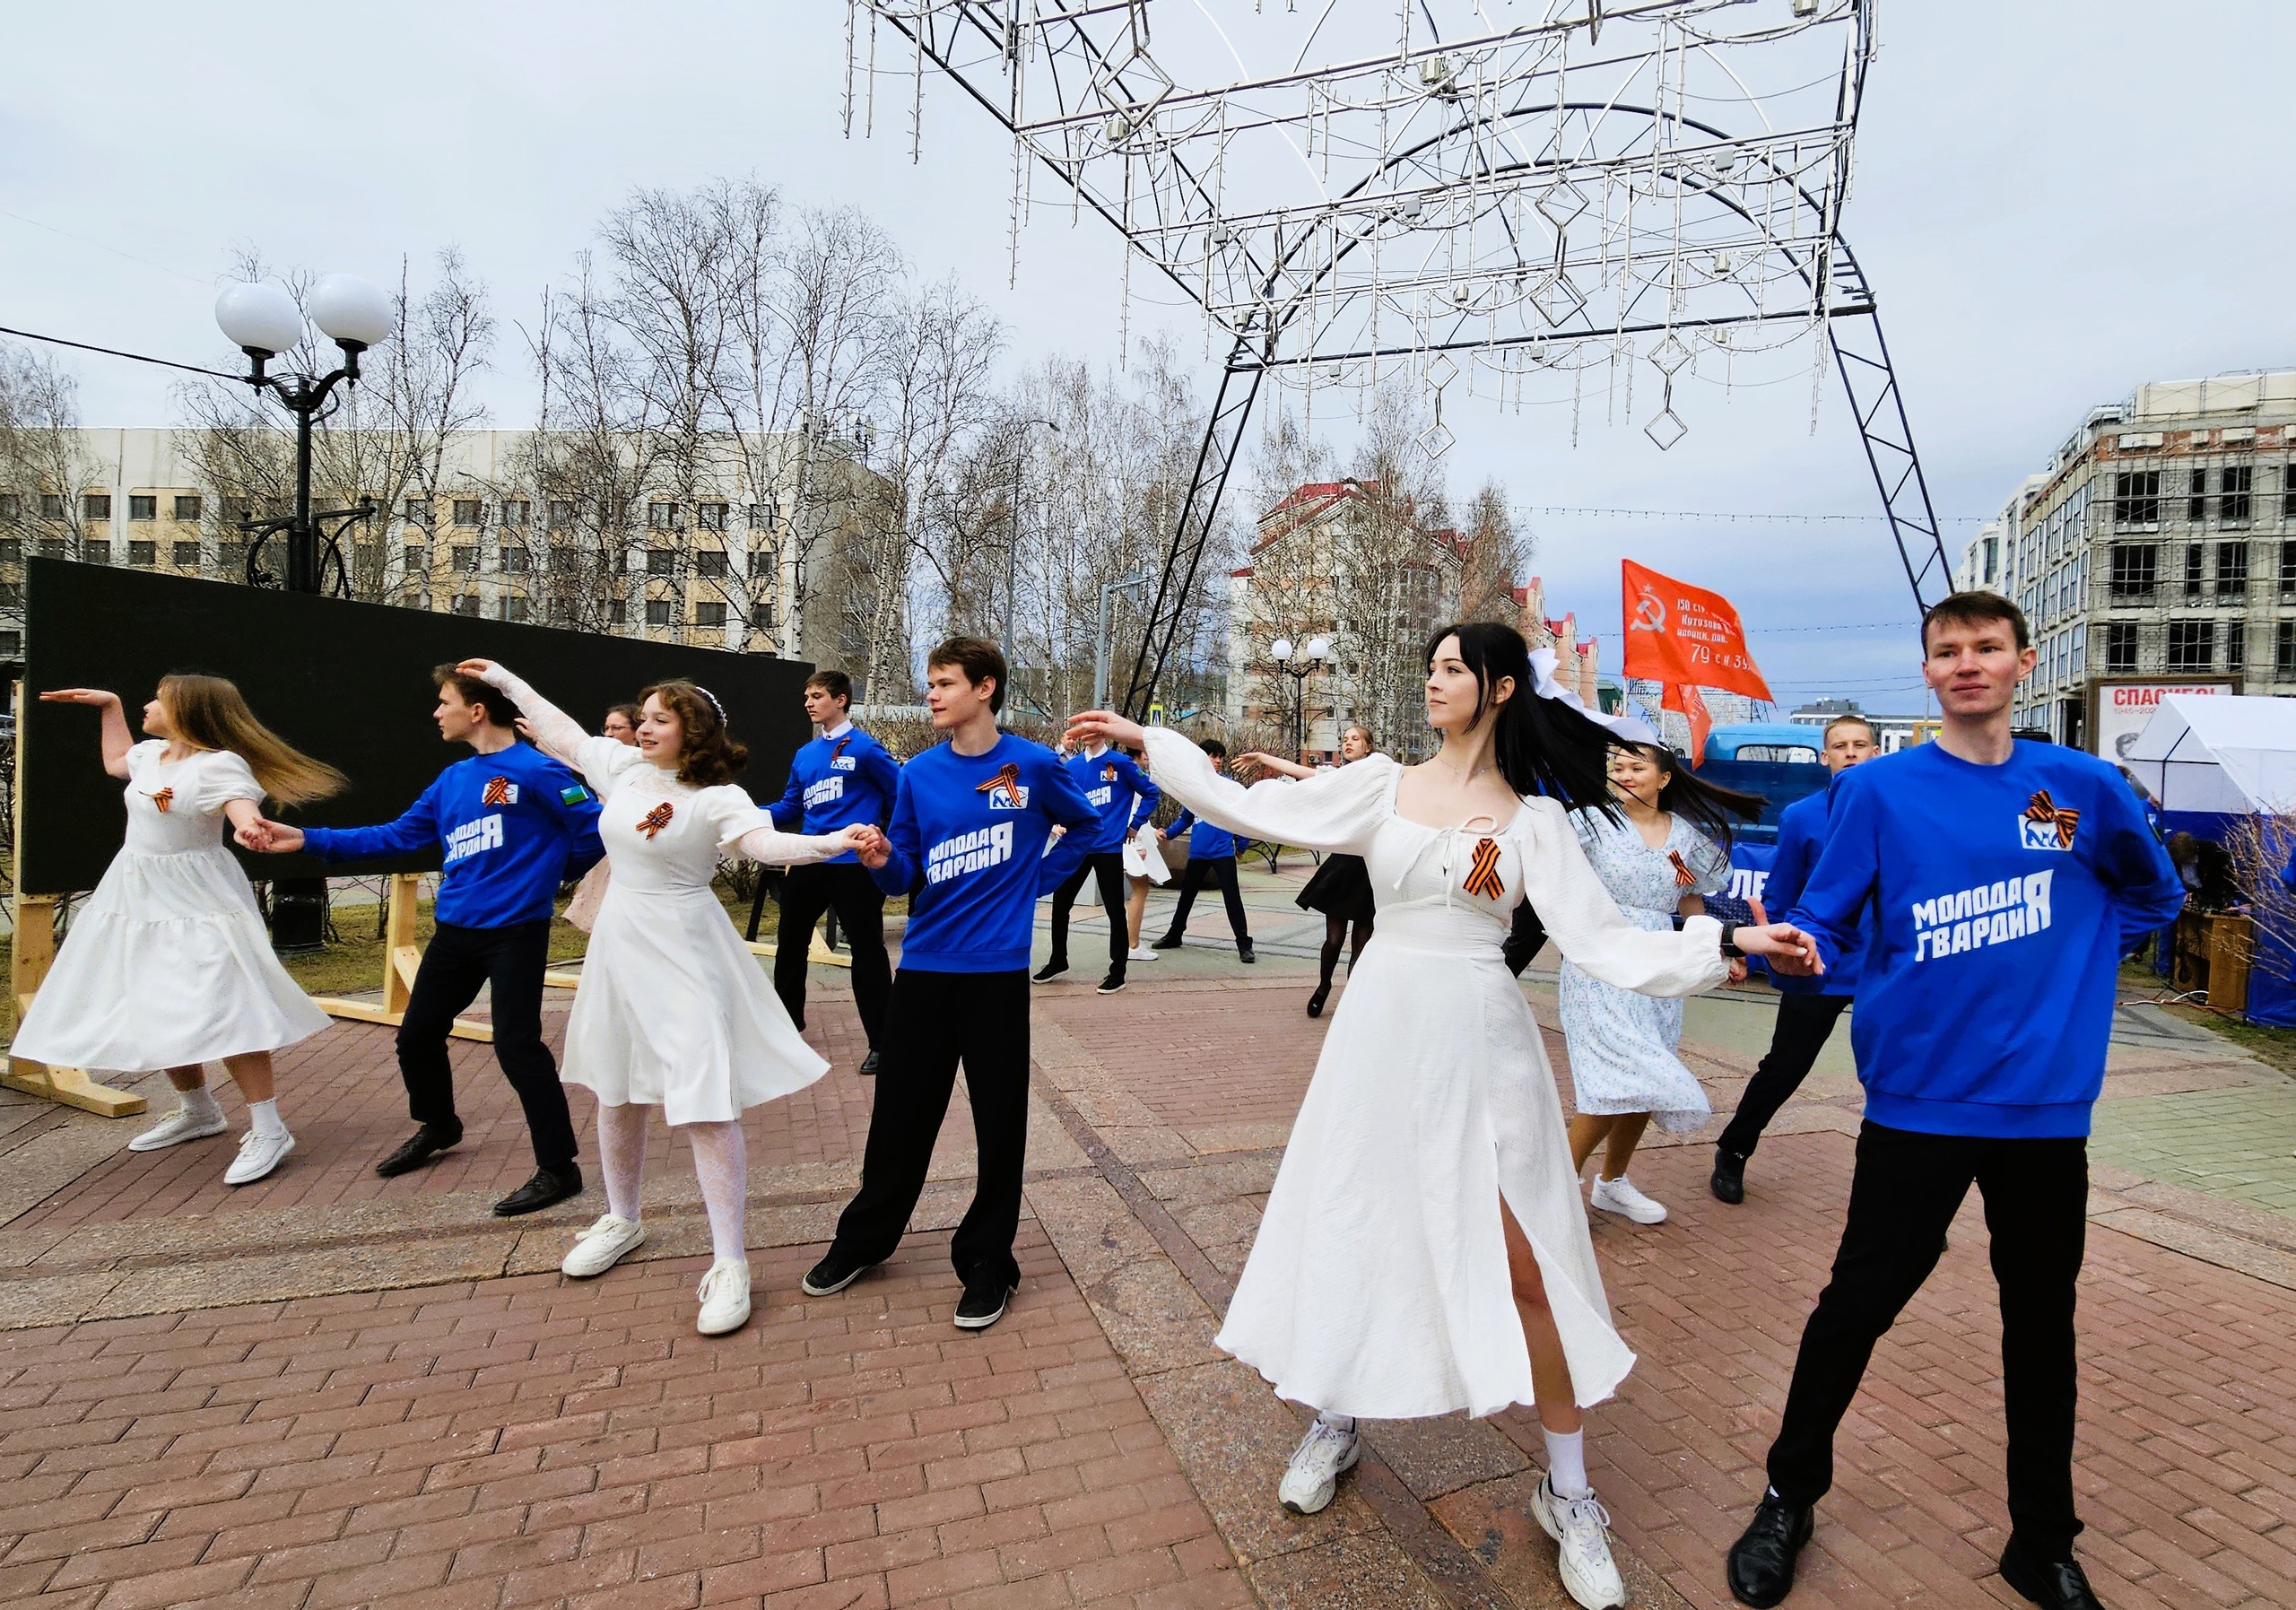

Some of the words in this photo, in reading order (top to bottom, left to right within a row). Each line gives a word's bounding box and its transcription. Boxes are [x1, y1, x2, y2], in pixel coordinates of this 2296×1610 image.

[1677, 598, 1691, 611] 150
[1691, 642, 1710, 664] 79
[2113, 687, 2215, 706] СПАС
[1912, 869, 2054, 930] МОЛОДАЯ
